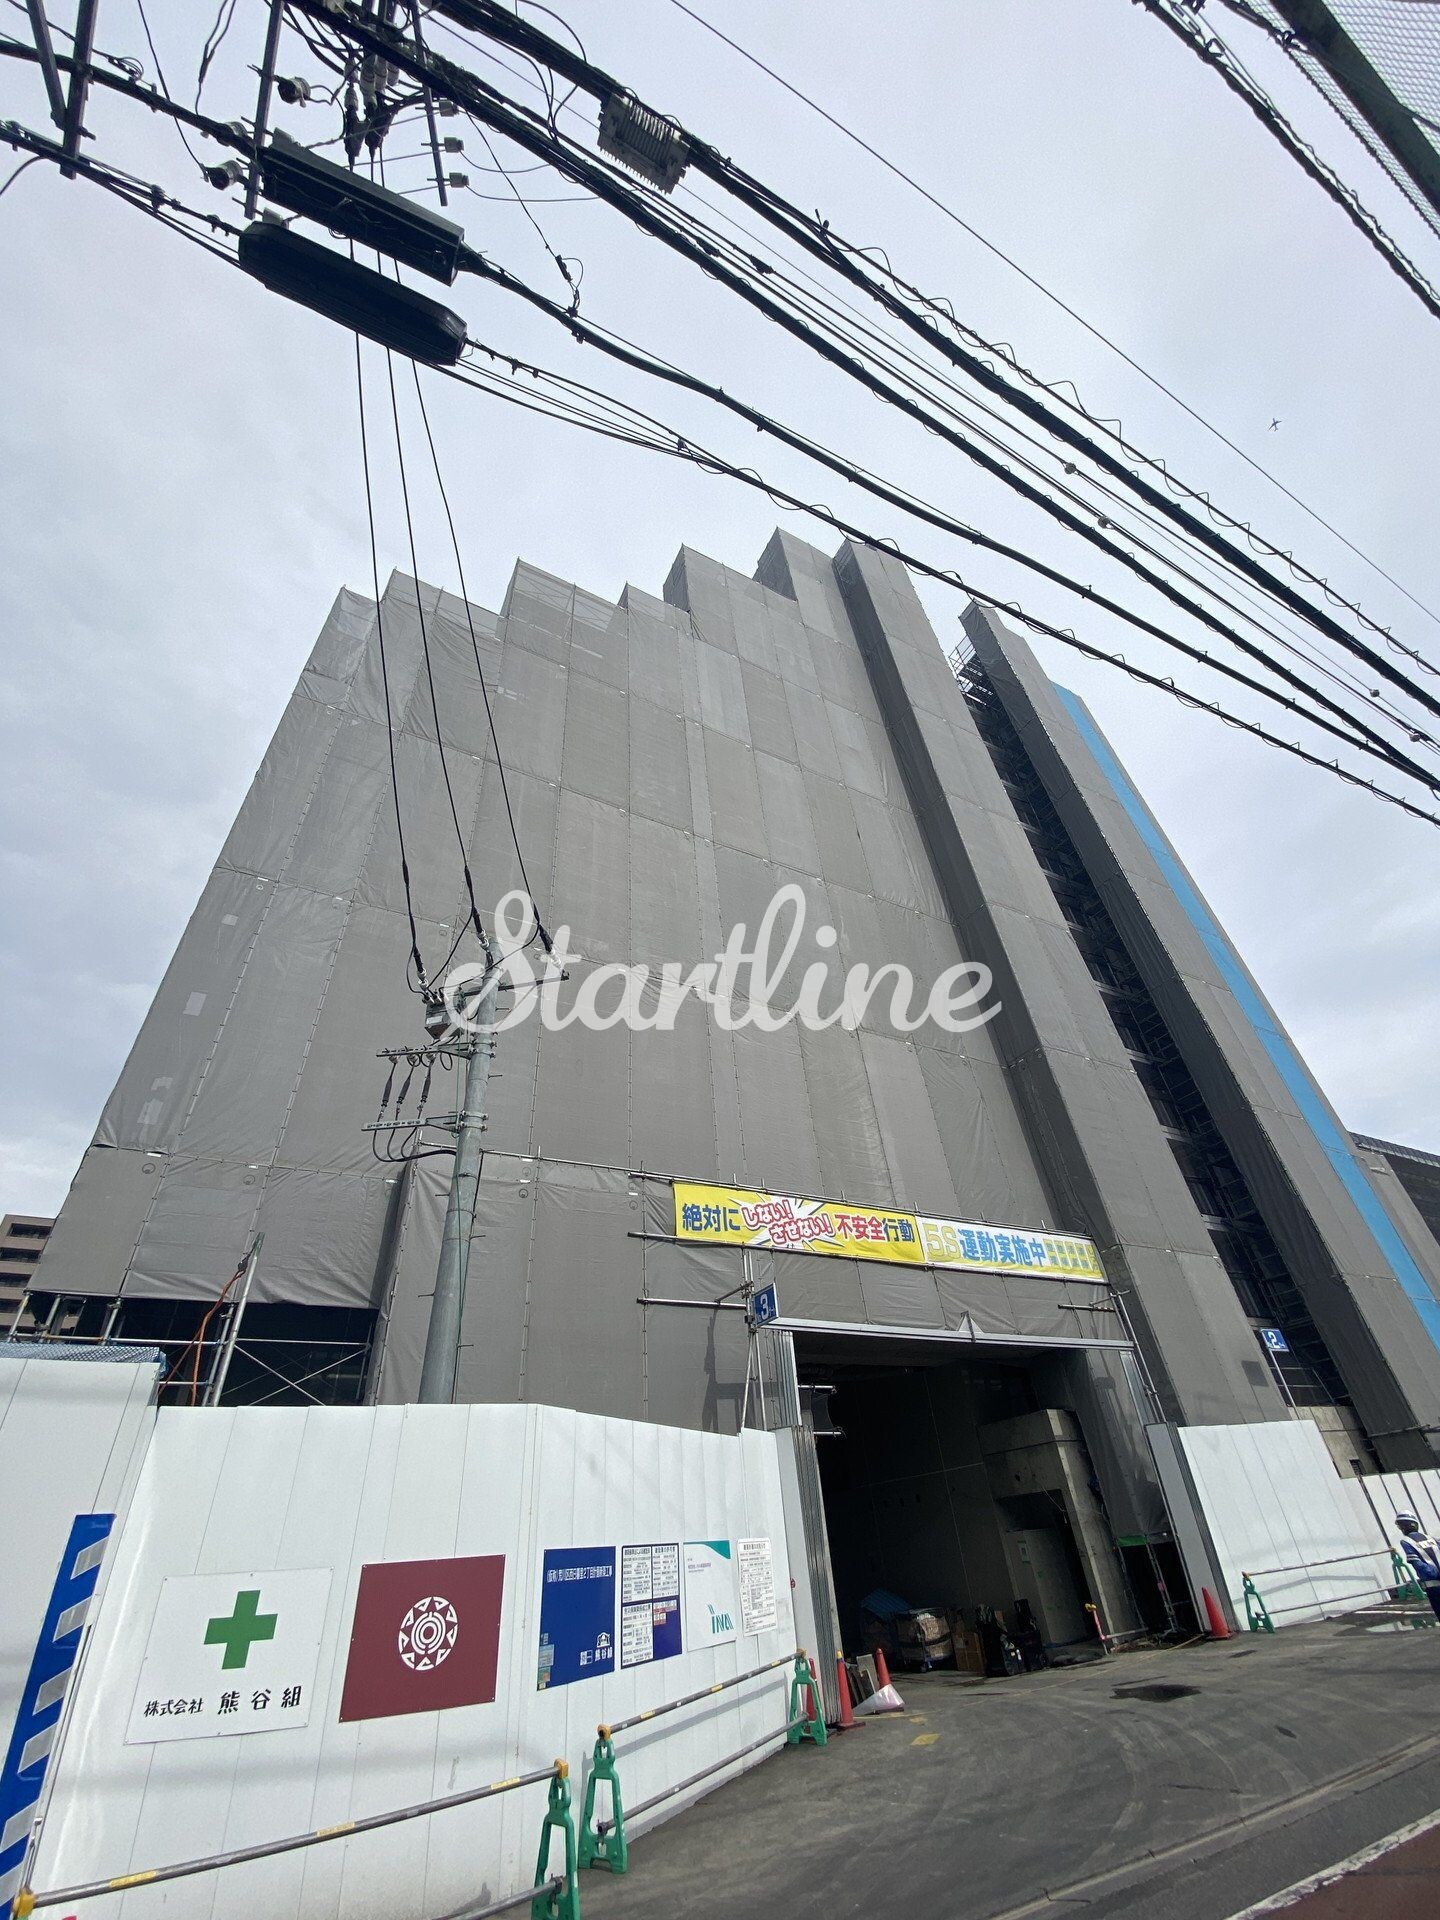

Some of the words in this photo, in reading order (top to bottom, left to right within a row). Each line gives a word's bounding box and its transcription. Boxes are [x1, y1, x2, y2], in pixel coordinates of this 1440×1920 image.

[682, 1203, 741, 1232] 絶対に
[834, 1213, 915, 1243] 不安全行動
[144, 1697, 204, 1717] 株式会社
[217, 1685, 303, 1715] 熊谷組
